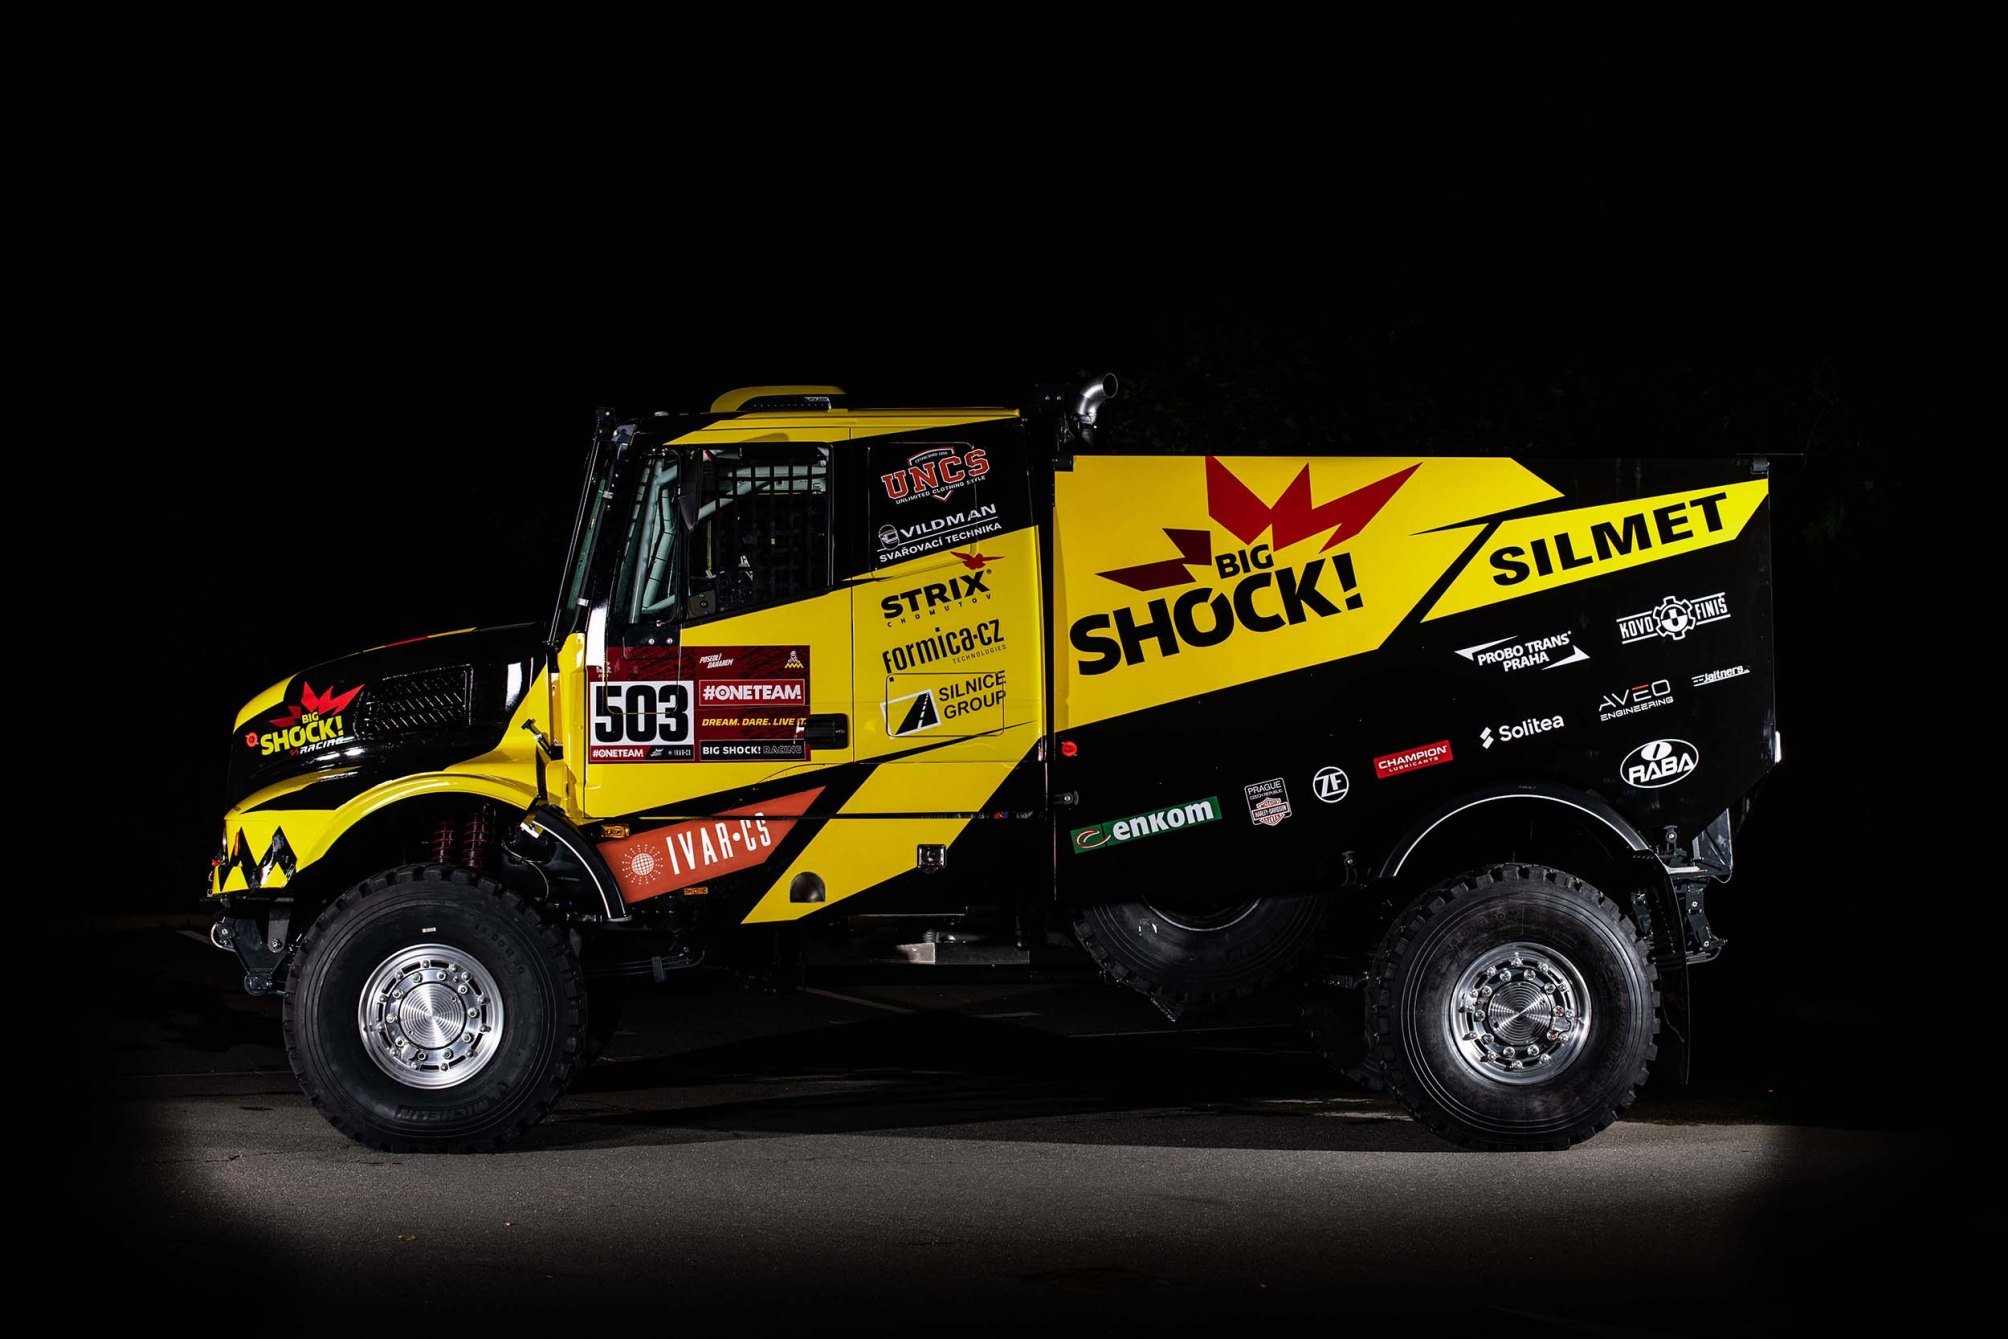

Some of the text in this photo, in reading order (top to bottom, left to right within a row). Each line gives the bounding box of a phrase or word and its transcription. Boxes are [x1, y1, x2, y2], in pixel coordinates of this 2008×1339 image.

[880, 449, 990, 500] UNCS
[896, 475, 986, 505] UNLIMITED CLOTHING STYLE
[899, 503, 997, 538] VILDMAN
[879, 522, 1002, 563] SVAŘOVACÍ TECHNIKA
[1489, 491, 1727, 587] SILMET
[1215, 544, 1274, 580] BIG
[881, 570, 990, 619] STRIX
[887, 593, 992, 628] CHOMUTOV
[1069, 552, 1365, 676] SHOCK!
[1619, 595, 1728, 639] KOVO FINIŠ
[952, 644, 1007, 664] TECHNOLOGIES
[1477, 645, 1524, 666] PROBO
[1503, 652, 1550, 672] PRAHA
[939, 669, 1007, 702] SILNICE
[1598, 679, 1671, 711] AVEO
[302, 711, 319, 724] BIG
[595, 684, 689, 743] 503
[943, 690, 1007, 719] GROUP
[1600, 696, 1674, 722] ENGINEERING
[260, 715, 344, 756] SHOCK!
[702, 718, 740, 726] DREAM.
[742, 718, 771, 726] DARE.
[773, 718, 794, 726] LIVE
[1498, 714, 1565, 742] Solitea
[703, 745, 802, 755] BIG SHOCK! RACING
[1378, 746, 1447, 770] CHAMPION
[1388, 756, 1439, 773] LUBRICANTS
[1247, 780, 1282, 795] PRAGUE
[1319, 771, 1344, 798] ZF
[1112, 800, 1214, 842] enkom
